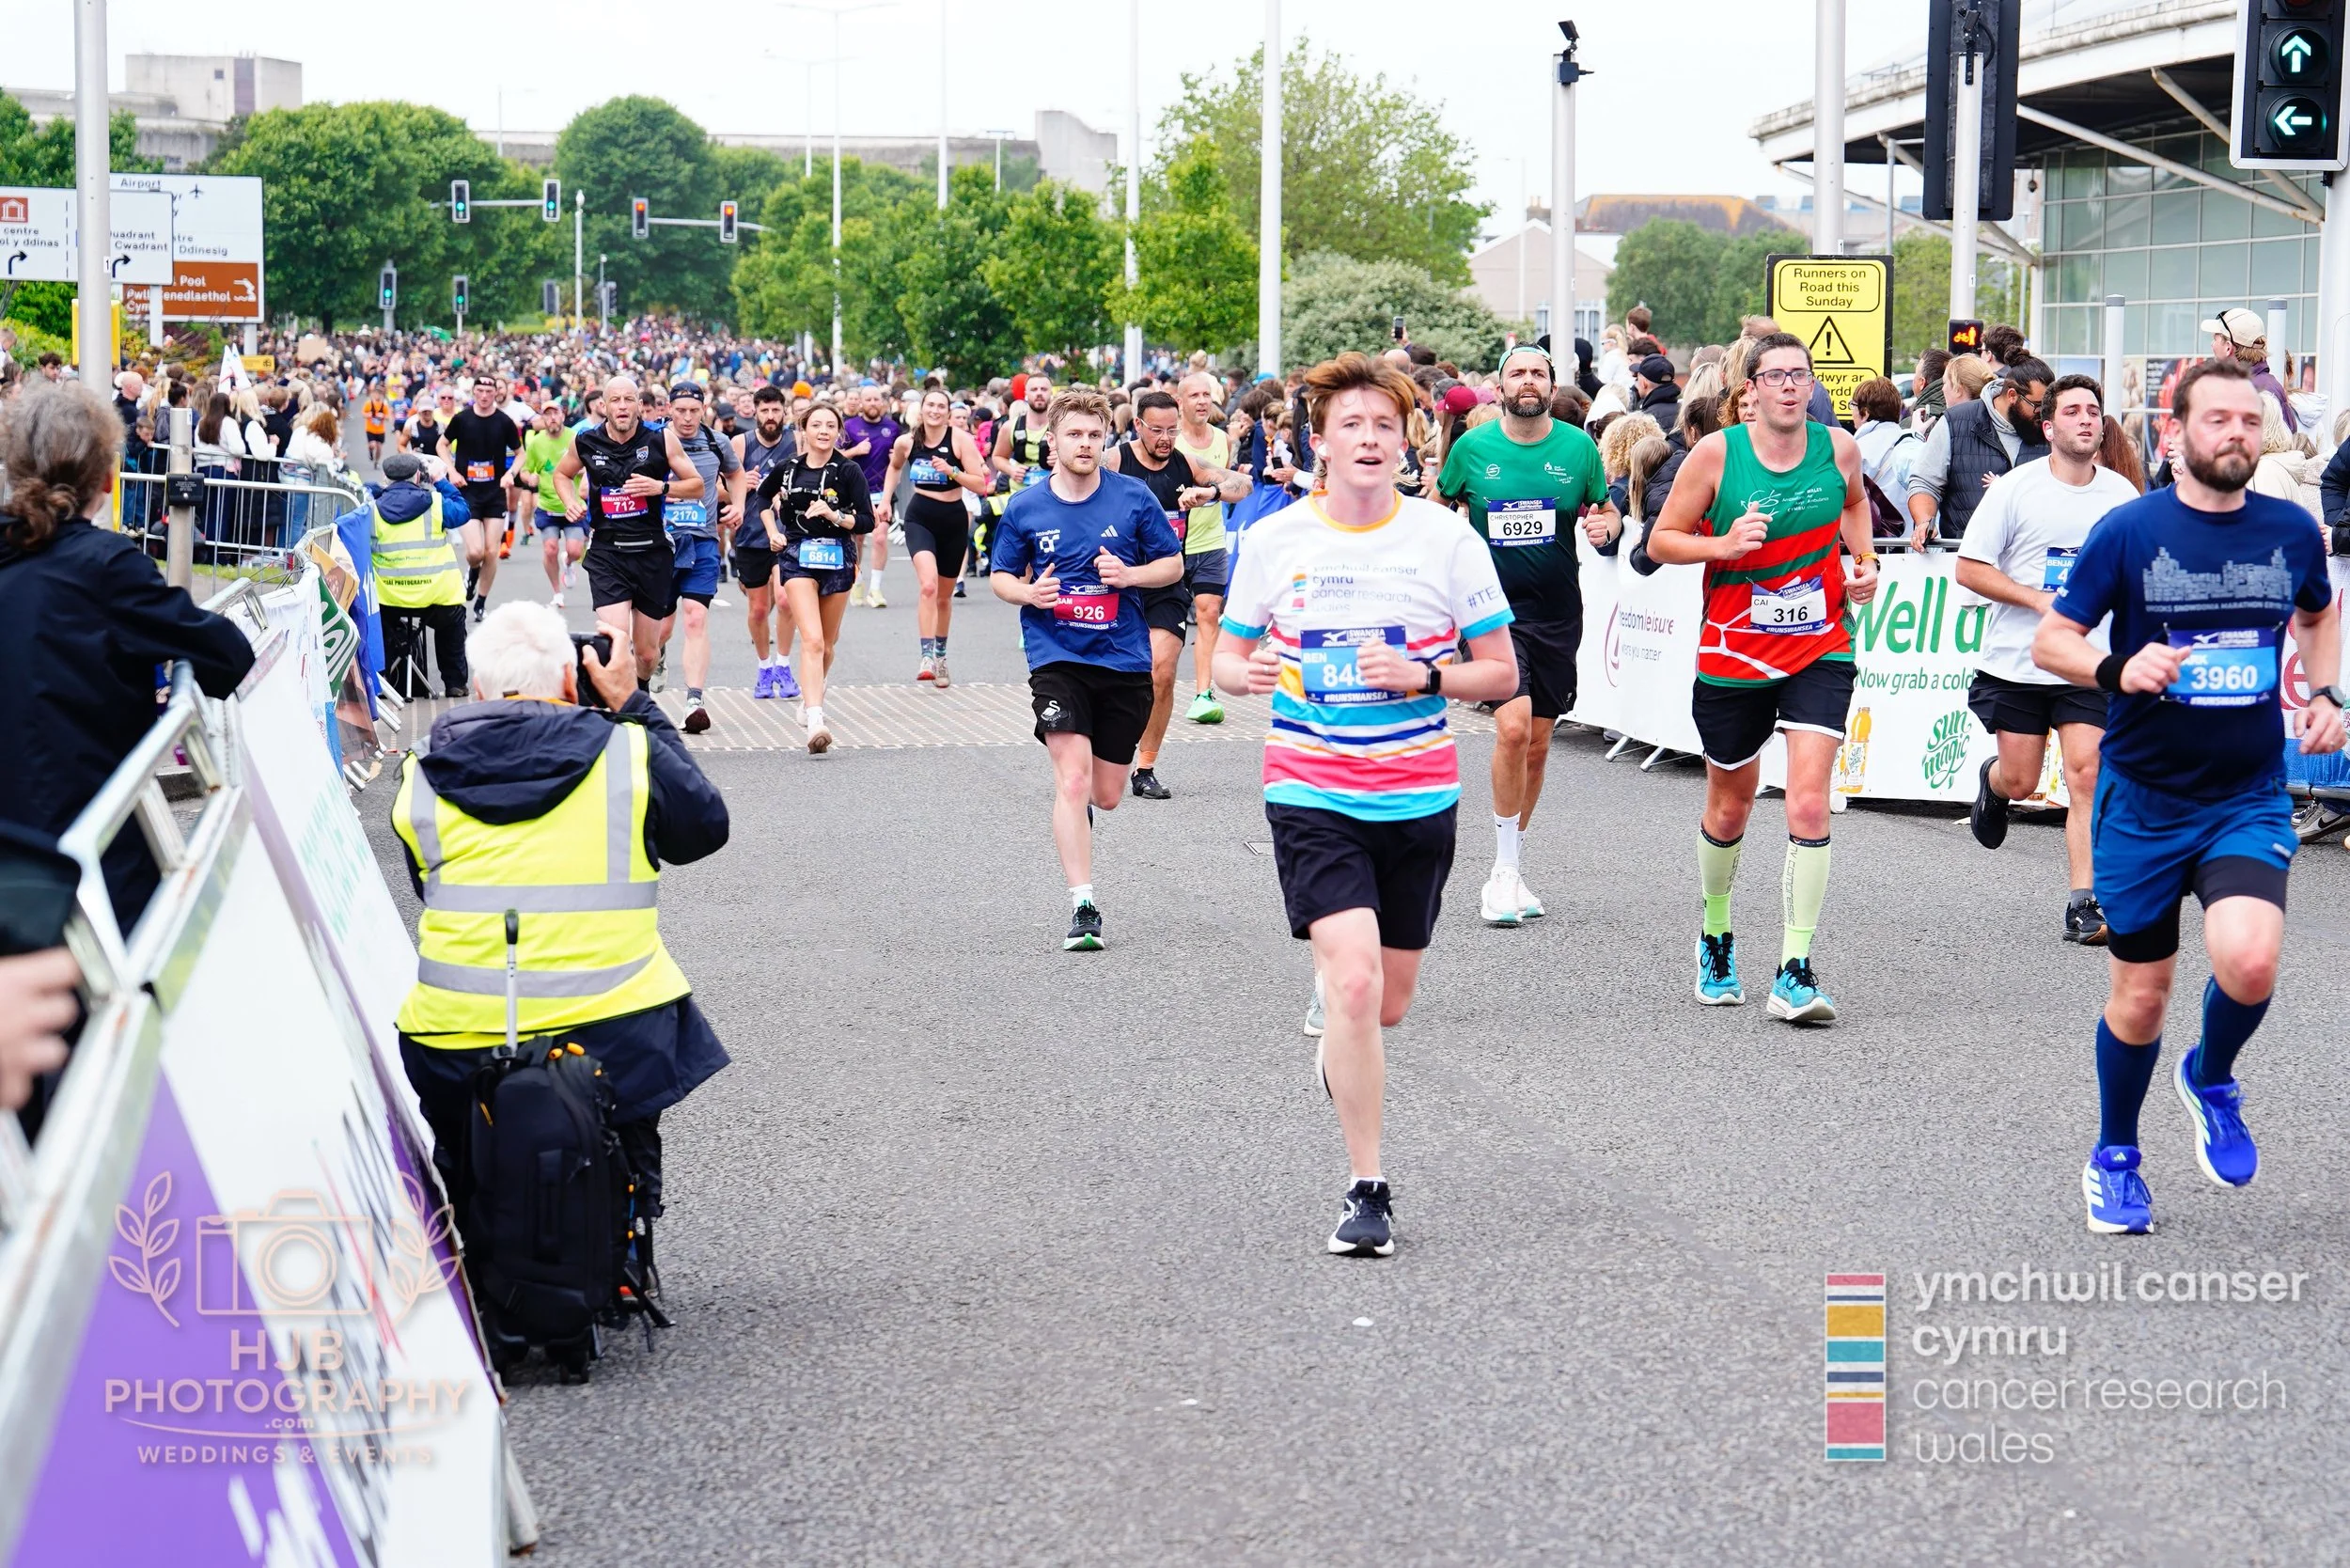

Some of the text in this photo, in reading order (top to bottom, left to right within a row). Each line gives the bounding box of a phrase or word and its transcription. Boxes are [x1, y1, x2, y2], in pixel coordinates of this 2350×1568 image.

[120, 179, 161, 190] Airport
[4, 227, 39, 235] centre
[110, 230, 155, 240] uadrant
[24, 237, 59, 247] ddinas
[115, 241, 168, 252] Cwadrant
[179, 245, 228, 257] Ddinesig
[1794, 268, 1867, 278] Runners on
[180, 274, 207, 288] Pool
[1799, 281, 1860, 292] Road this
[161, 290, 231, 303] enedlaethol
[1806, 295, 1853, 309] Sunday
[1813, 372, 1865, 384] dwyr ar
[602, 494, 631, 503] SAMANTHA
[613, 500, 636, 512] 712
[672, 510, 698, 521] 2170
[1489, 513, 1534, 522] CHRISTOPHER
[1503, 521, 1543, 537] 6929
[808, 551, 837, 563] 6814
[2046, 558, 2076, 568] BENJA
[1312, 575, 1354, 587] cymru
[1057, 597, 1073, 605] SAM
[1311, 588, 1412, 603] cancer research
[1753, 598, 1769, 606] CAI
[2220, 601, 2264, 610] MARATHON
[1073, 604, 1105, 620] 926
[1773, 605, 1809, 623] 316
[1847, 575, 1949, 654] Well
[1348, 628, 1386, 637] SWANSEA
[1765, 624, 1814, 634] #RUNSWANSEA
[1302, 652, 1328, 664] BEN
[1856, 666, 1975, 696] Now grab a cold
[2190, 665, 2259, 691] 3960
[1324, 691, 1389, 703] #RUNSWANSEA
[1927, 709, 1973, 751] sun
[1921, 734, 1970, 790] magic
